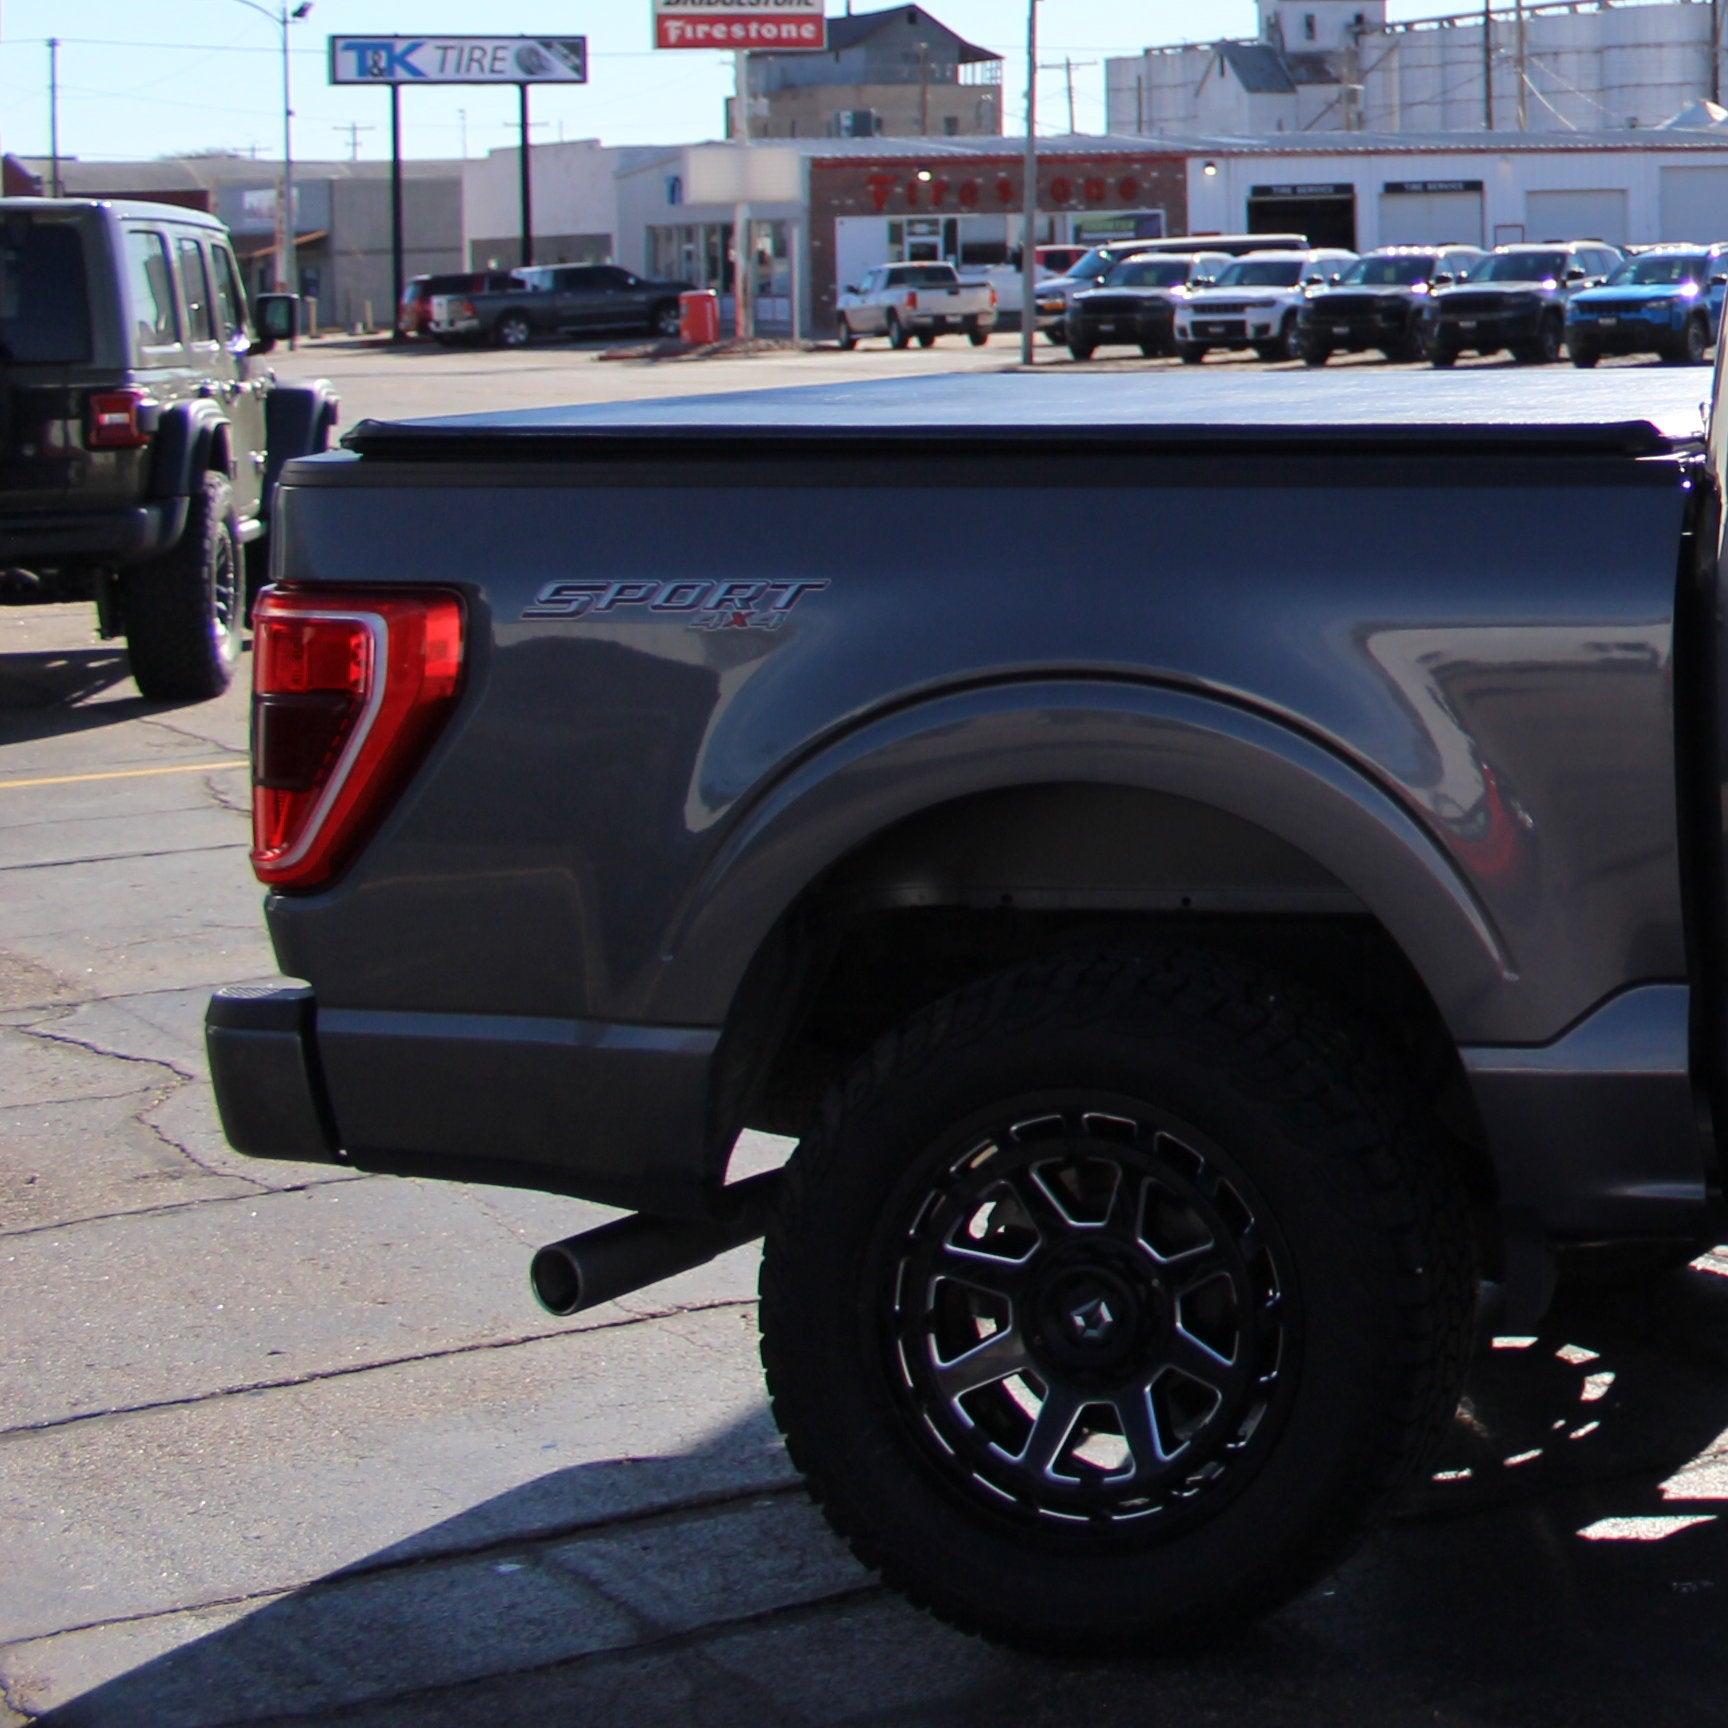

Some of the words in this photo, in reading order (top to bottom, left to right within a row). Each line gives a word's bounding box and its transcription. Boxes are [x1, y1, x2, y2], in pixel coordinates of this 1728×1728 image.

[663, 18, 817, 44] Firestone
[341, 41, 430, 78] T&K
[434, 44, 511, 76] TIRE
[865, 173, 1140, 212] Firesone
[520, 577, 832, 621] SPORT
